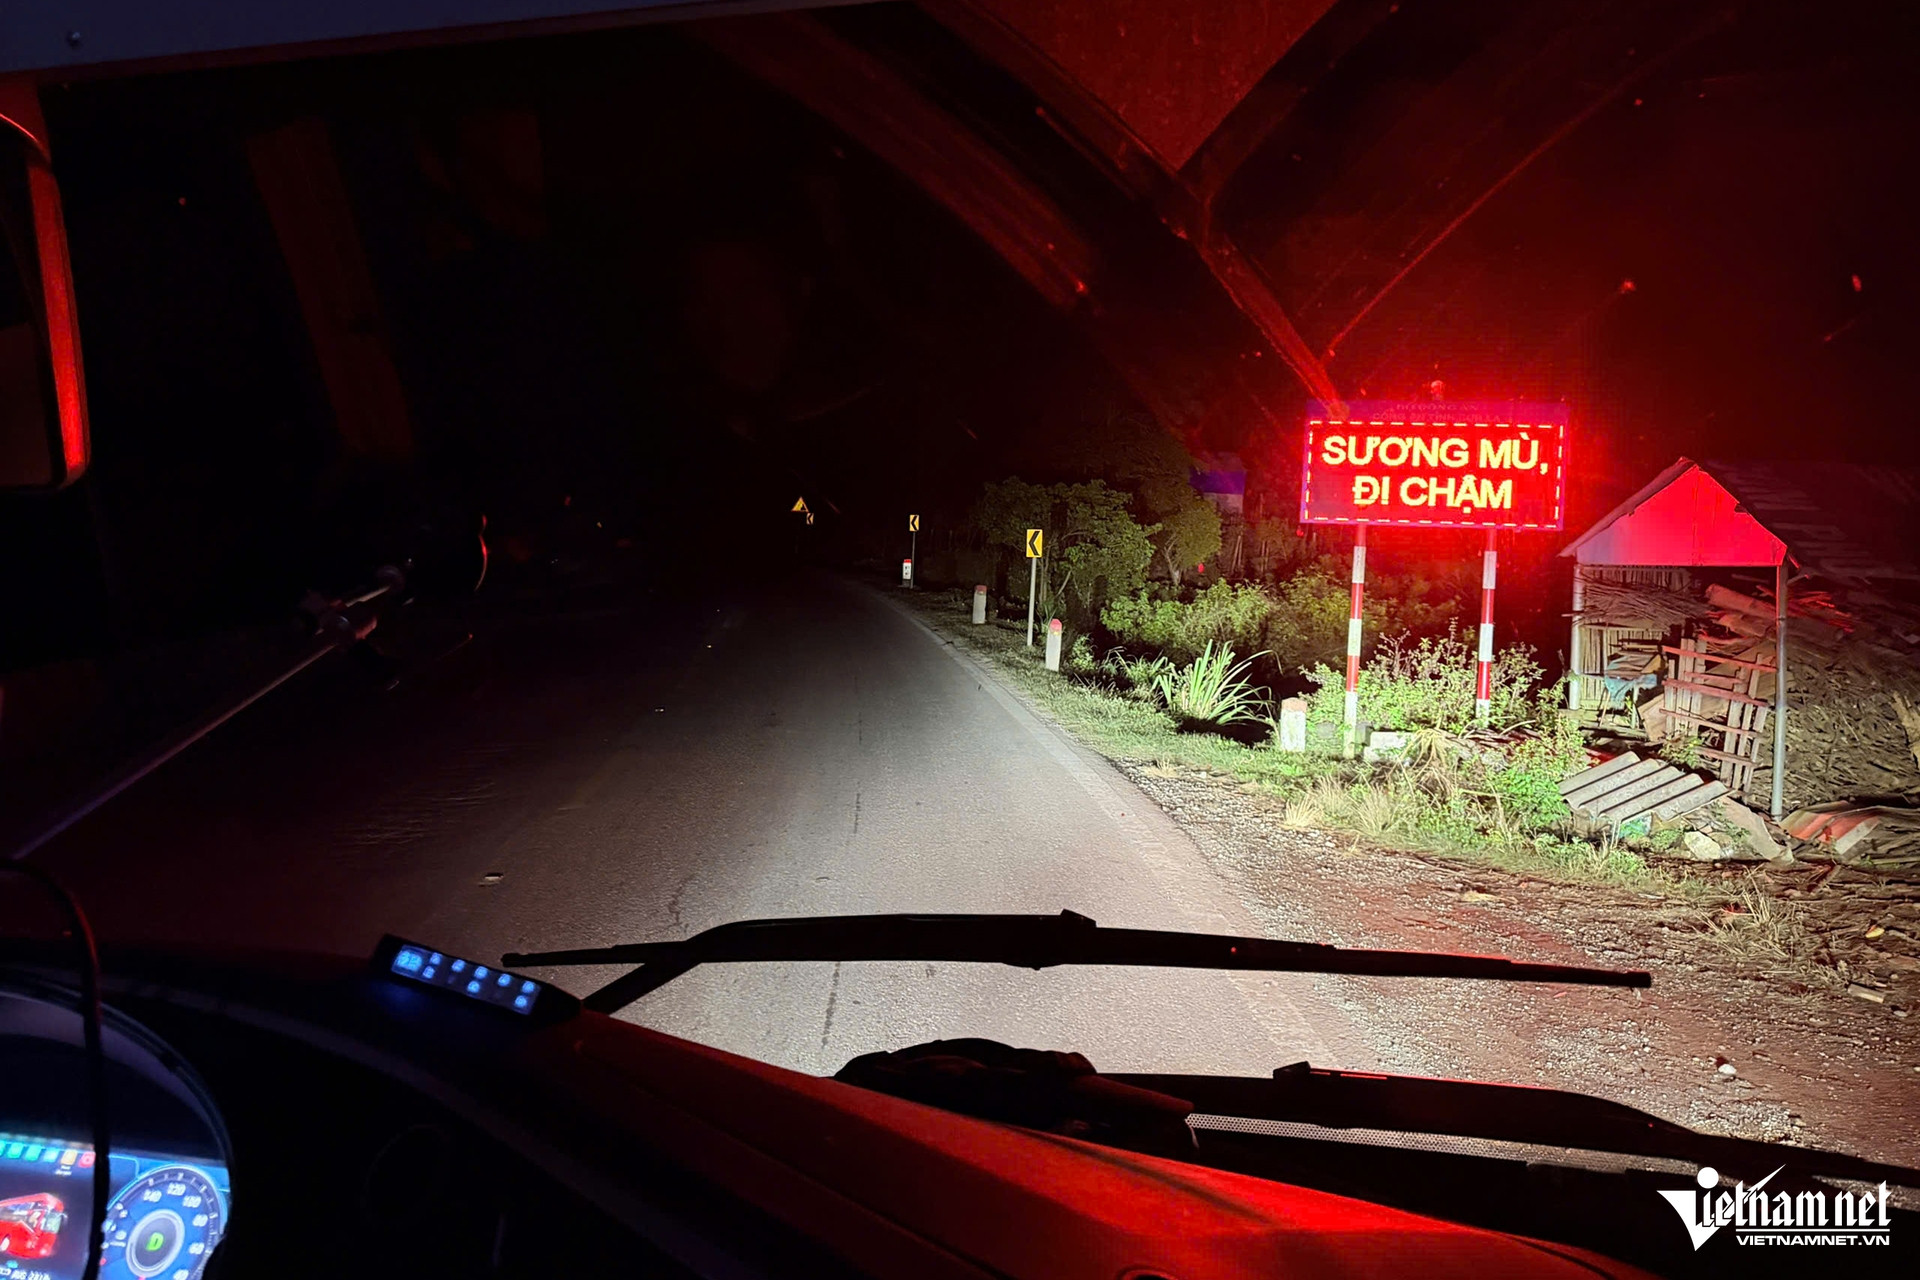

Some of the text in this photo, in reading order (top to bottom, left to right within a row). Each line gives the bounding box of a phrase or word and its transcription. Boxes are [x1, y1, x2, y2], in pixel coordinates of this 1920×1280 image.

[1322, 432, 1549, 475] SƯƠNG MÙ,
[1352, 474, 1513, 514] ĐI CHẬM
[145, 1232, 164, 1252] D
